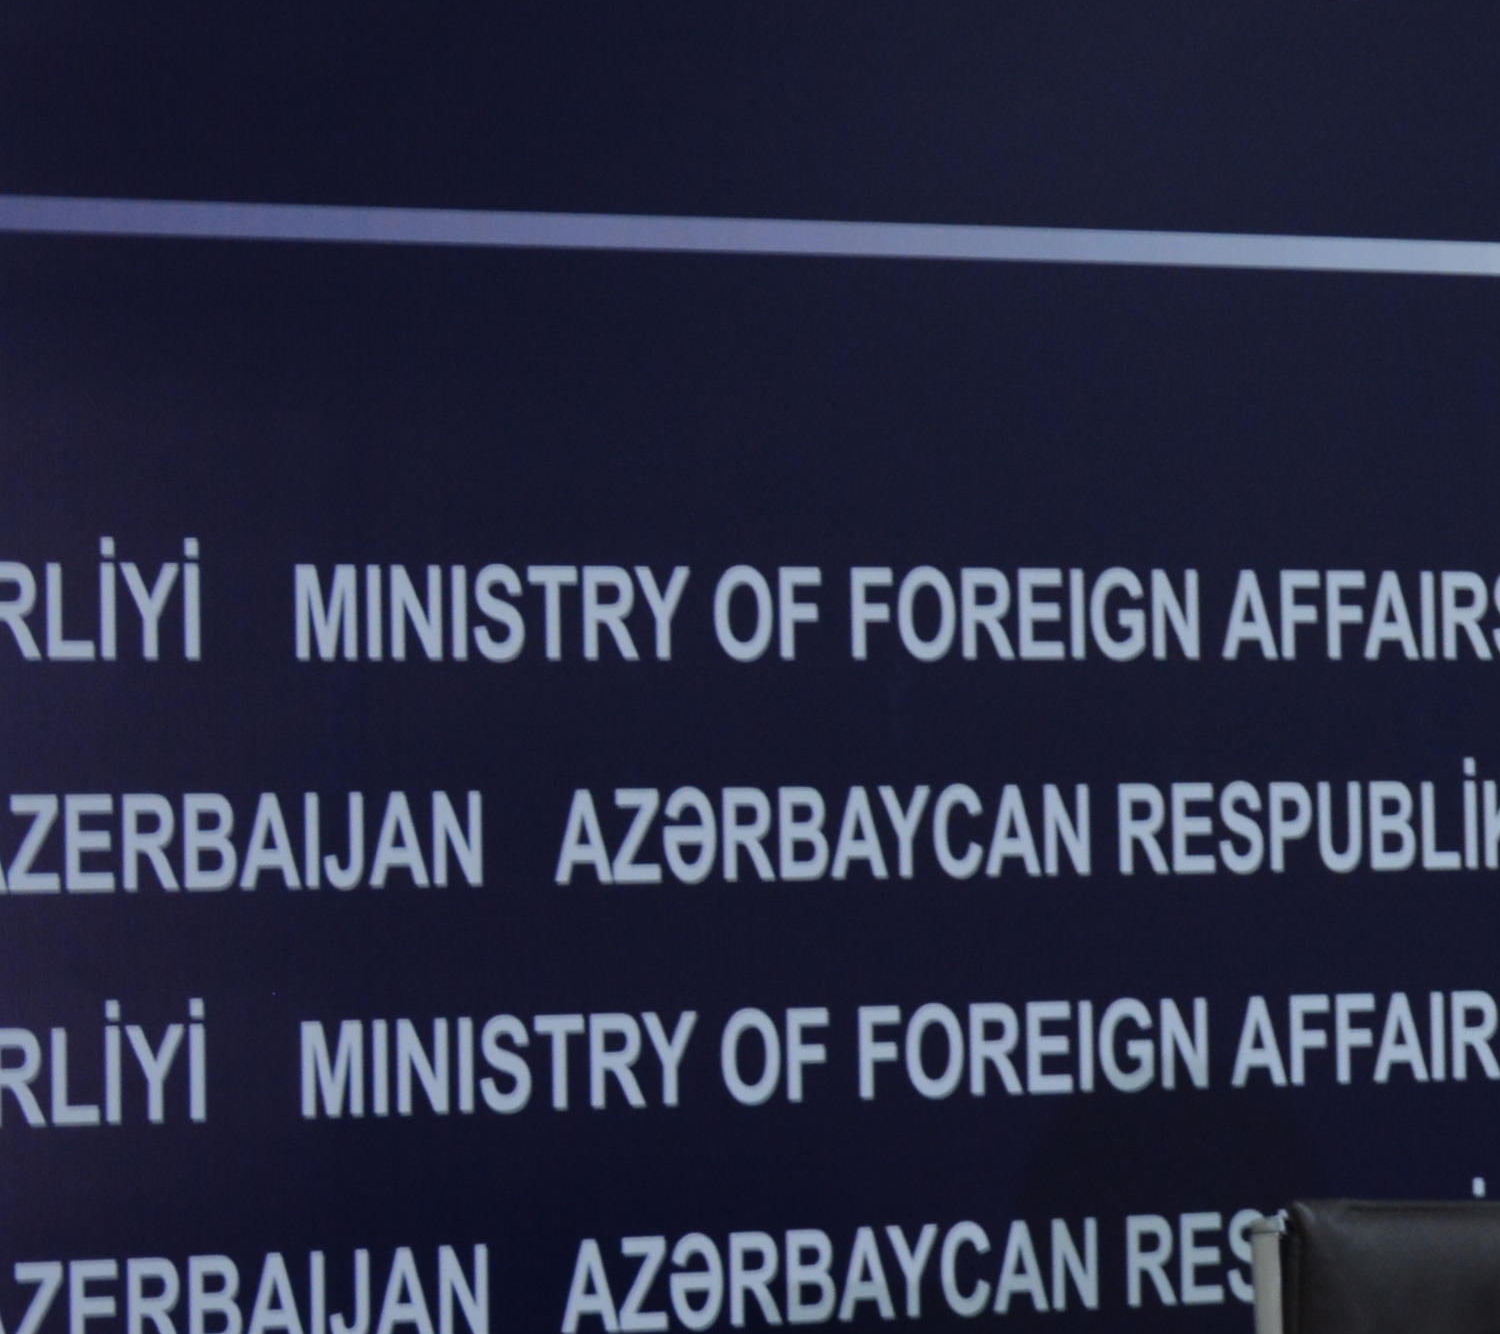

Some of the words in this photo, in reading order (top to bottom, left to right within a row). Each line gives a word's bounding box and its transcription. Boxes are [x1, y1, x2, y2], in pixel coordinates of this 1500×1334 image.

[294, 563, 691, 663] MINISTRY
[713, 564, 822, 663] OF
[850, 565, 1200, 662] FOREIGN
[554, 783, 1092, 885] AZƏRBAYCAN
[300, 1010, 698, 1119] MINISTRY
[720, 1007, 830, 1106] OF
[857, 997, 1209, 1101] FOREIGN
